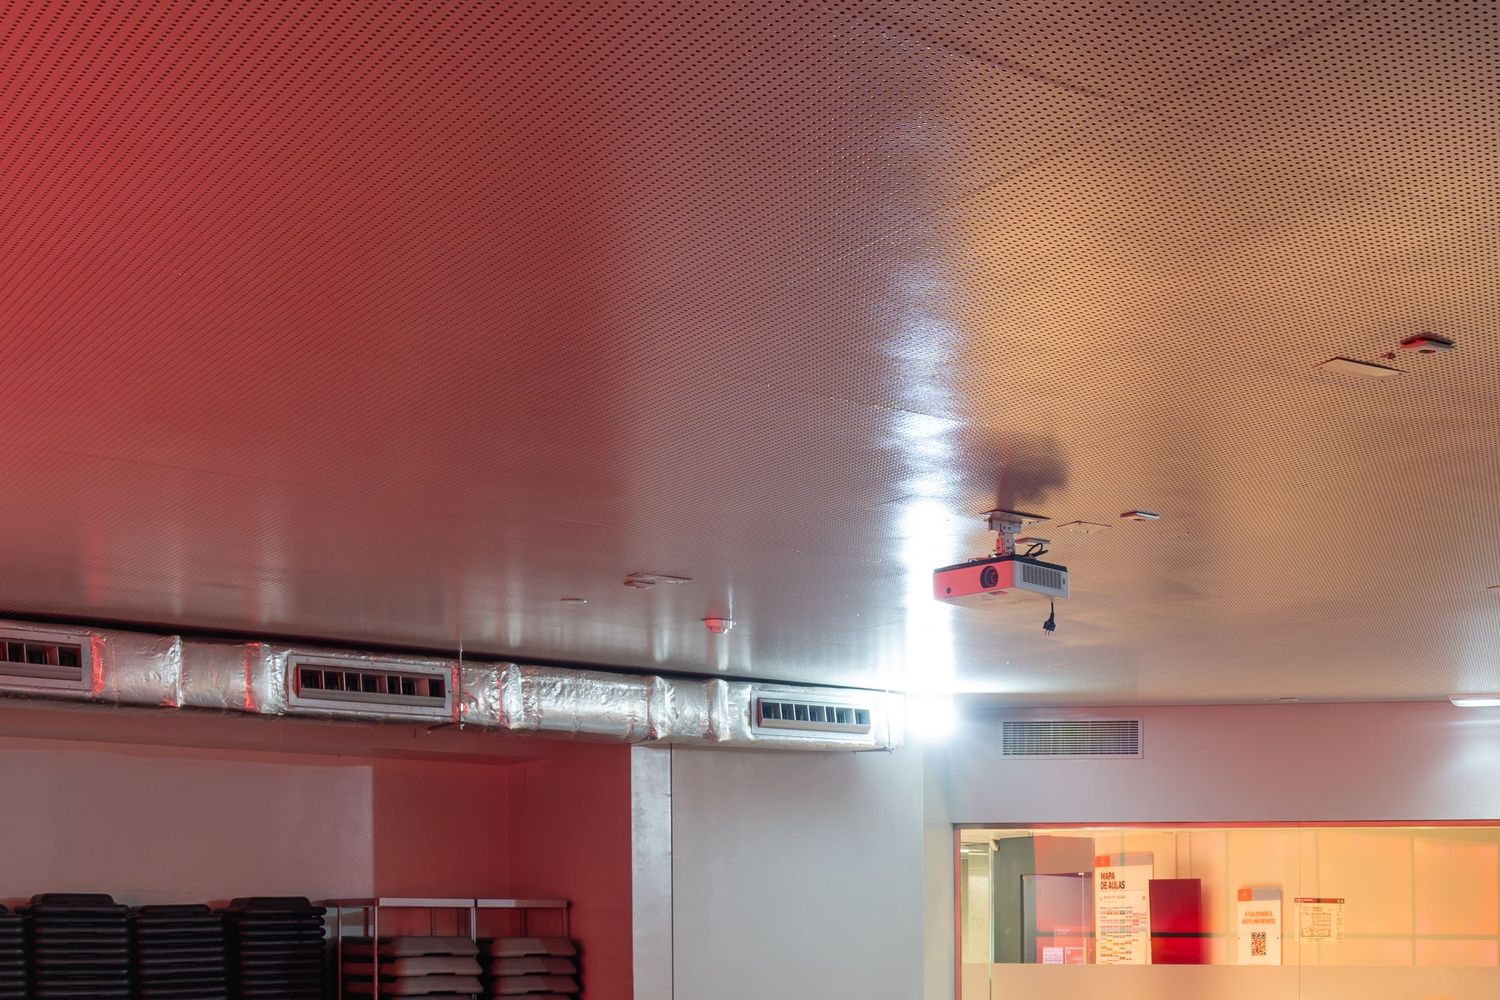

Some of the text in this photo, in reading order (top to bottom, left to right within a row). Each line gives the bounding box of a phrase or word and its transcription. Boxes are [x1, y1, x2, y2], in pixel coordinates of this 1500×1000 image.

[1100, 872, 1115, 880] MAPA
[1100, 880, 1125, 890] DE AULAS
